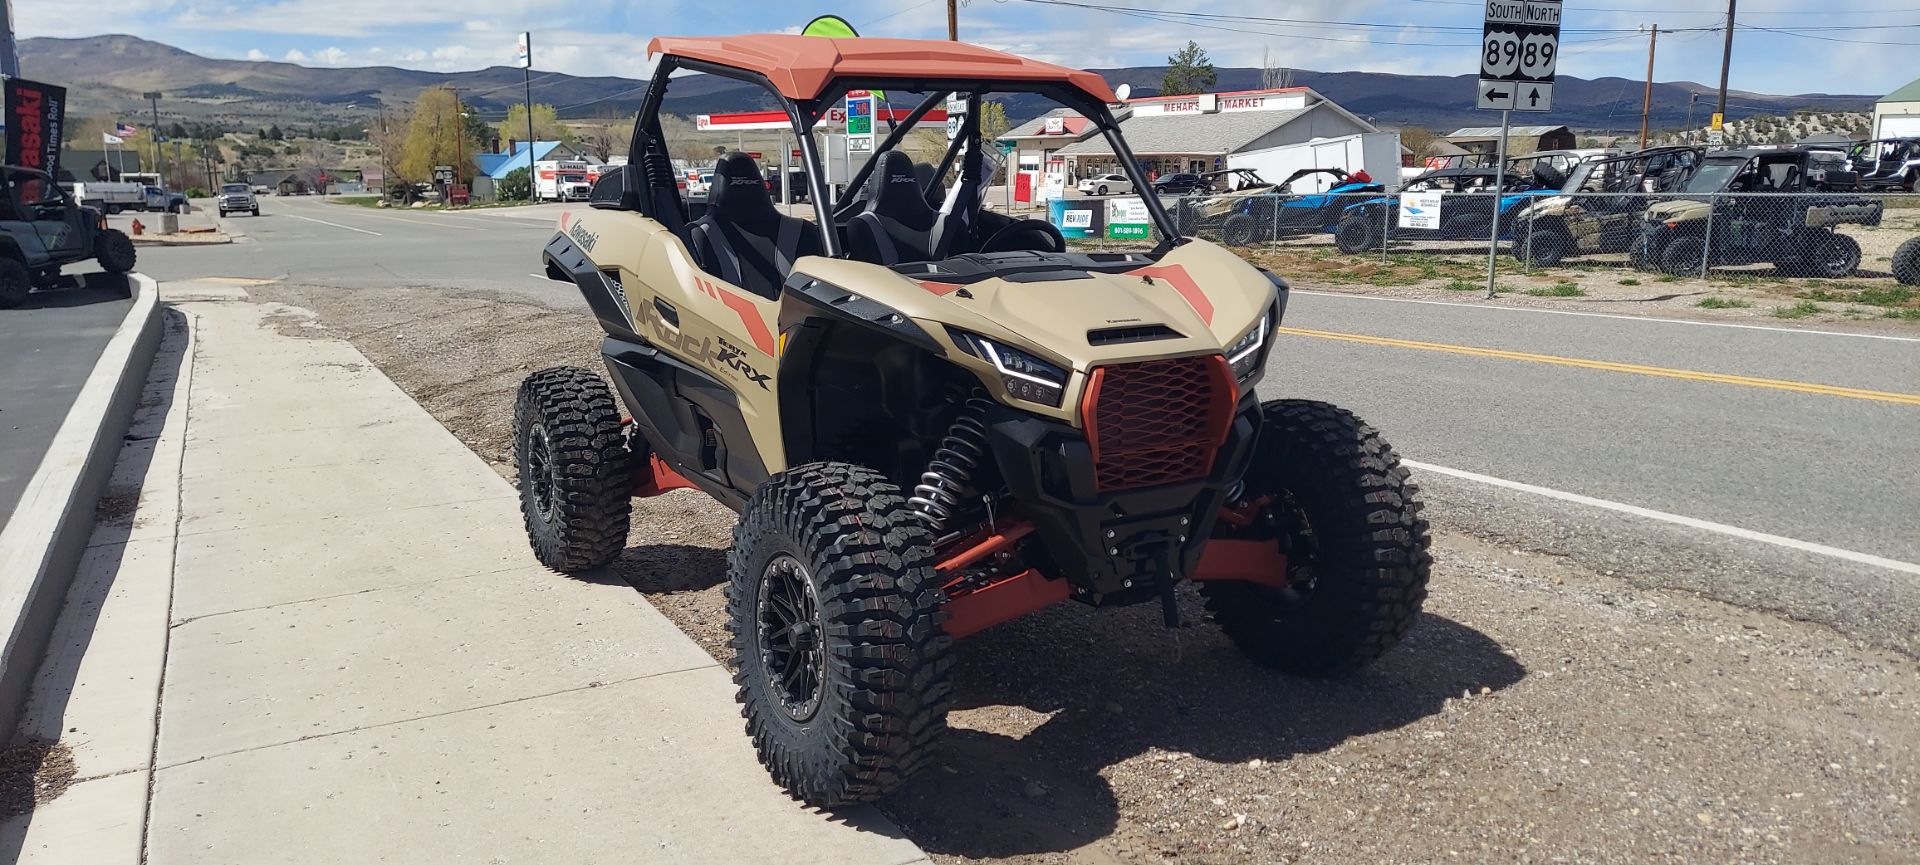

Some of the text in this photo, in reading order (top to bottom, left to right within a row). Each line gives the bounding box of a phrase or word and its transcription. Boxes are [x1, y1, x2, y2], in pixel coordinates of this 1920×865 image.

[1488, 2, 1522, 19] SOUTH
[1526, 5, 1560, 21] NORTH
[1486, 40, 1517, 66] 89
[1524, 42, 1554, 68] 89
[47, 100, 58, 121] Roll
[1164, 98, 1266, 112] MEHAR'S MARKET
[47, 122, 58, 153] Times
[569, 218, 599, 253] Kawasaki
[717, 346, 773, 393] KRX
